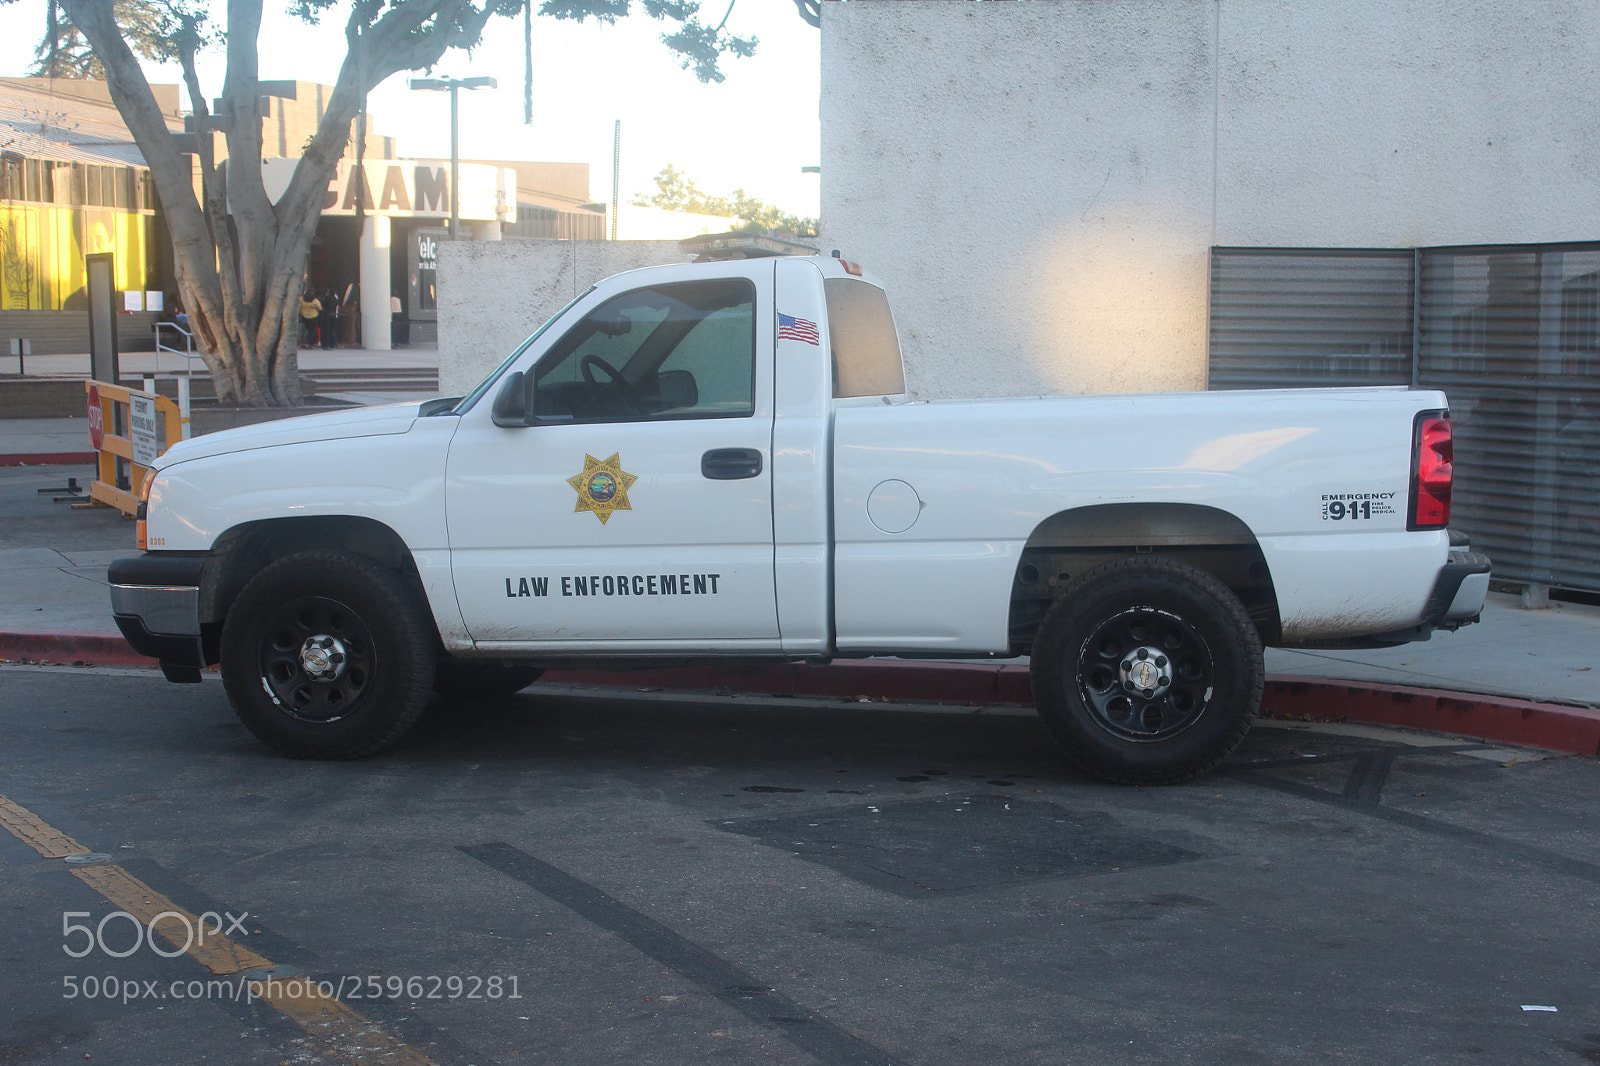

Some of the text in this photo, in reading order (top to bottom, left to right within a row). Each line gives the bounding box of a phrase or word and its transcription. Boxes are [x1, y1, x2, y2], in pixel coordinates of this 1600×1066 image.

[89, 405, 102, 430] STOP
[1321, 492, 1395, 501] EMERGENCY
[505, 574, 720, 597] LAW ENFORCEMENT
